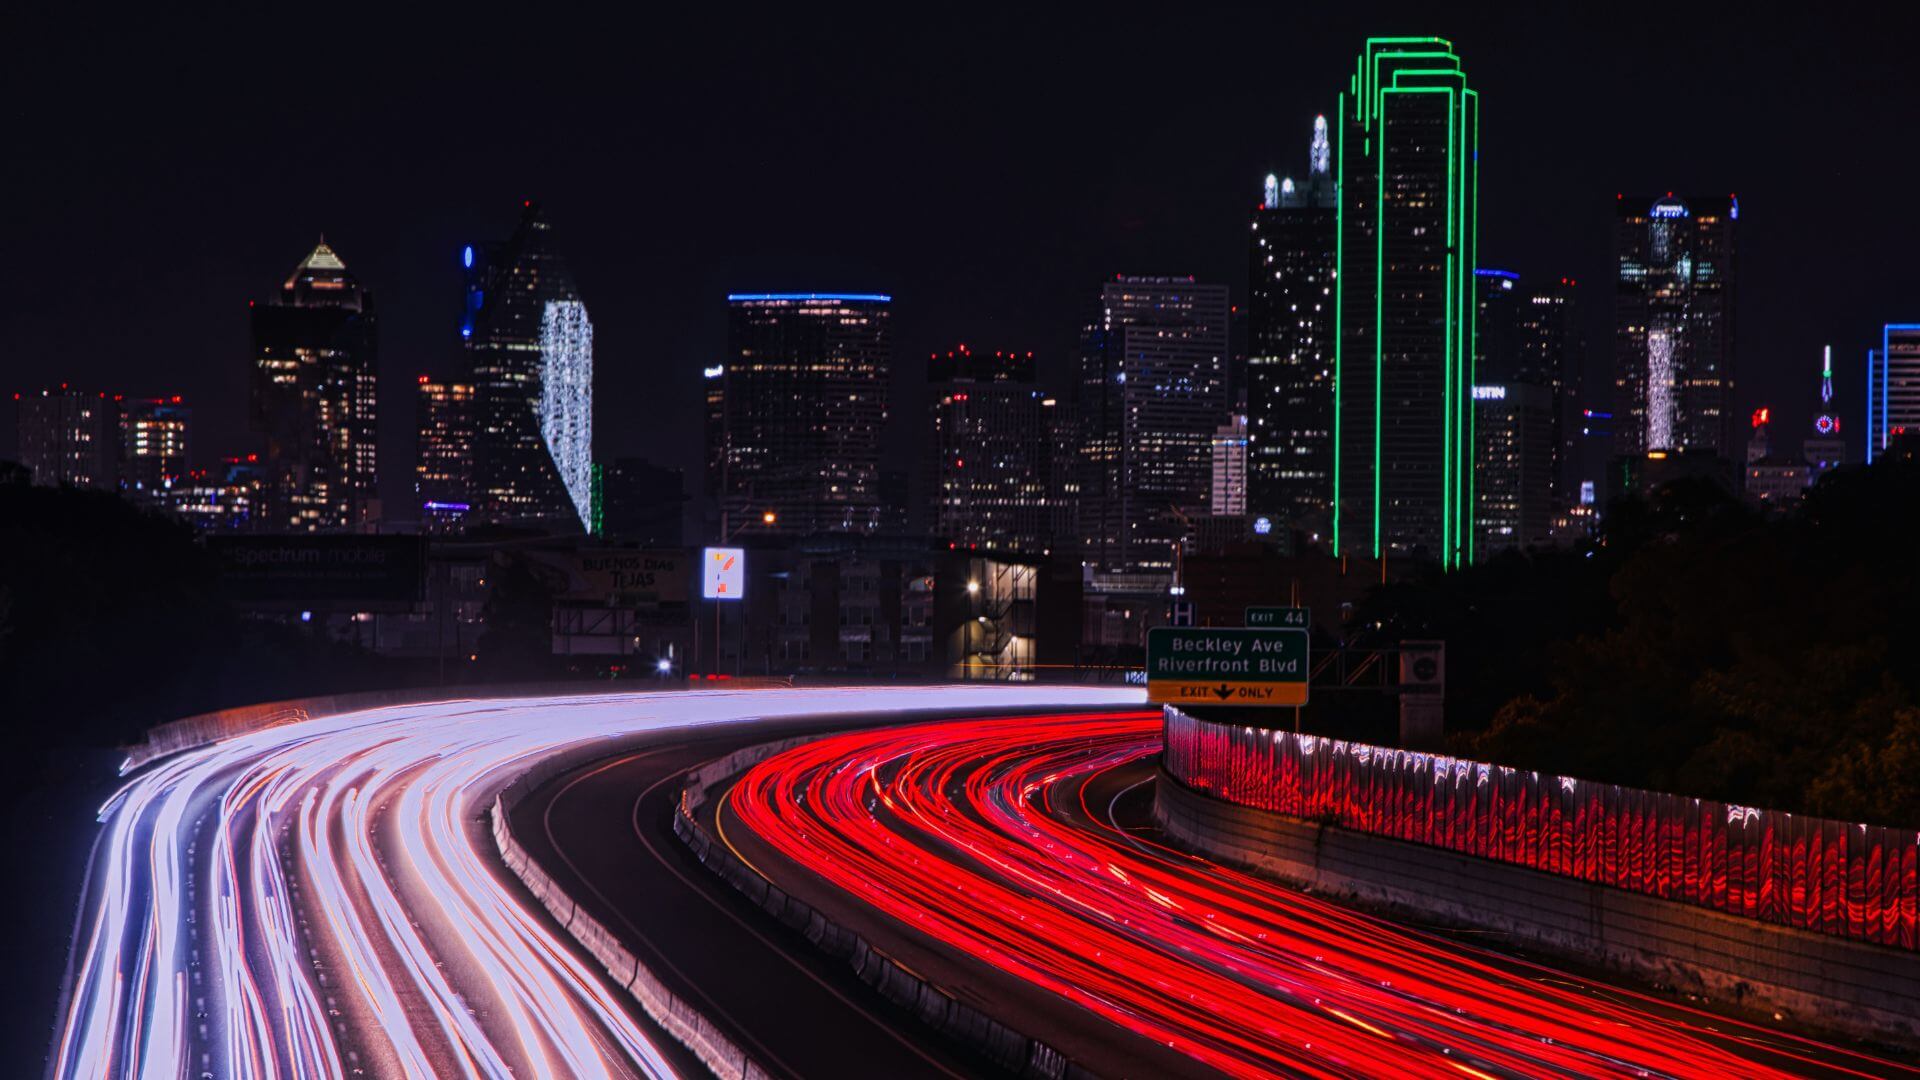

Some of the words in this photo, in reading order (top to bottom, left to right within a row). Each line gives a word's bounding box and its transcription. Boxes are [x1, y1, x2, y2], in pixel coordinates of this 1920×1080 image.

[1472, 386, 1505, 399] ESTIN
[234, 546, 320, 566] Spectrum
[328, 546, 386, 563] mobile
[583, 557, 640, 571] BUENOS
[610, 571, 655, 588] TEJAS
[1174, 603, 1192, 626] H
[1251, 613, 1274, 622] EXIT
[1285, 612, 1303, 624] 44
[1172, 638, 1242, 655] Beckley
[1252, 639, 1284, 652] Ave
[1158, 657, 1249, 672] Riverfront
[1259, 658, 1297, 672] Blvd
[1180, 687, 1209, 697] EXIT
[1239, 687, 1273, 698] ONLY
